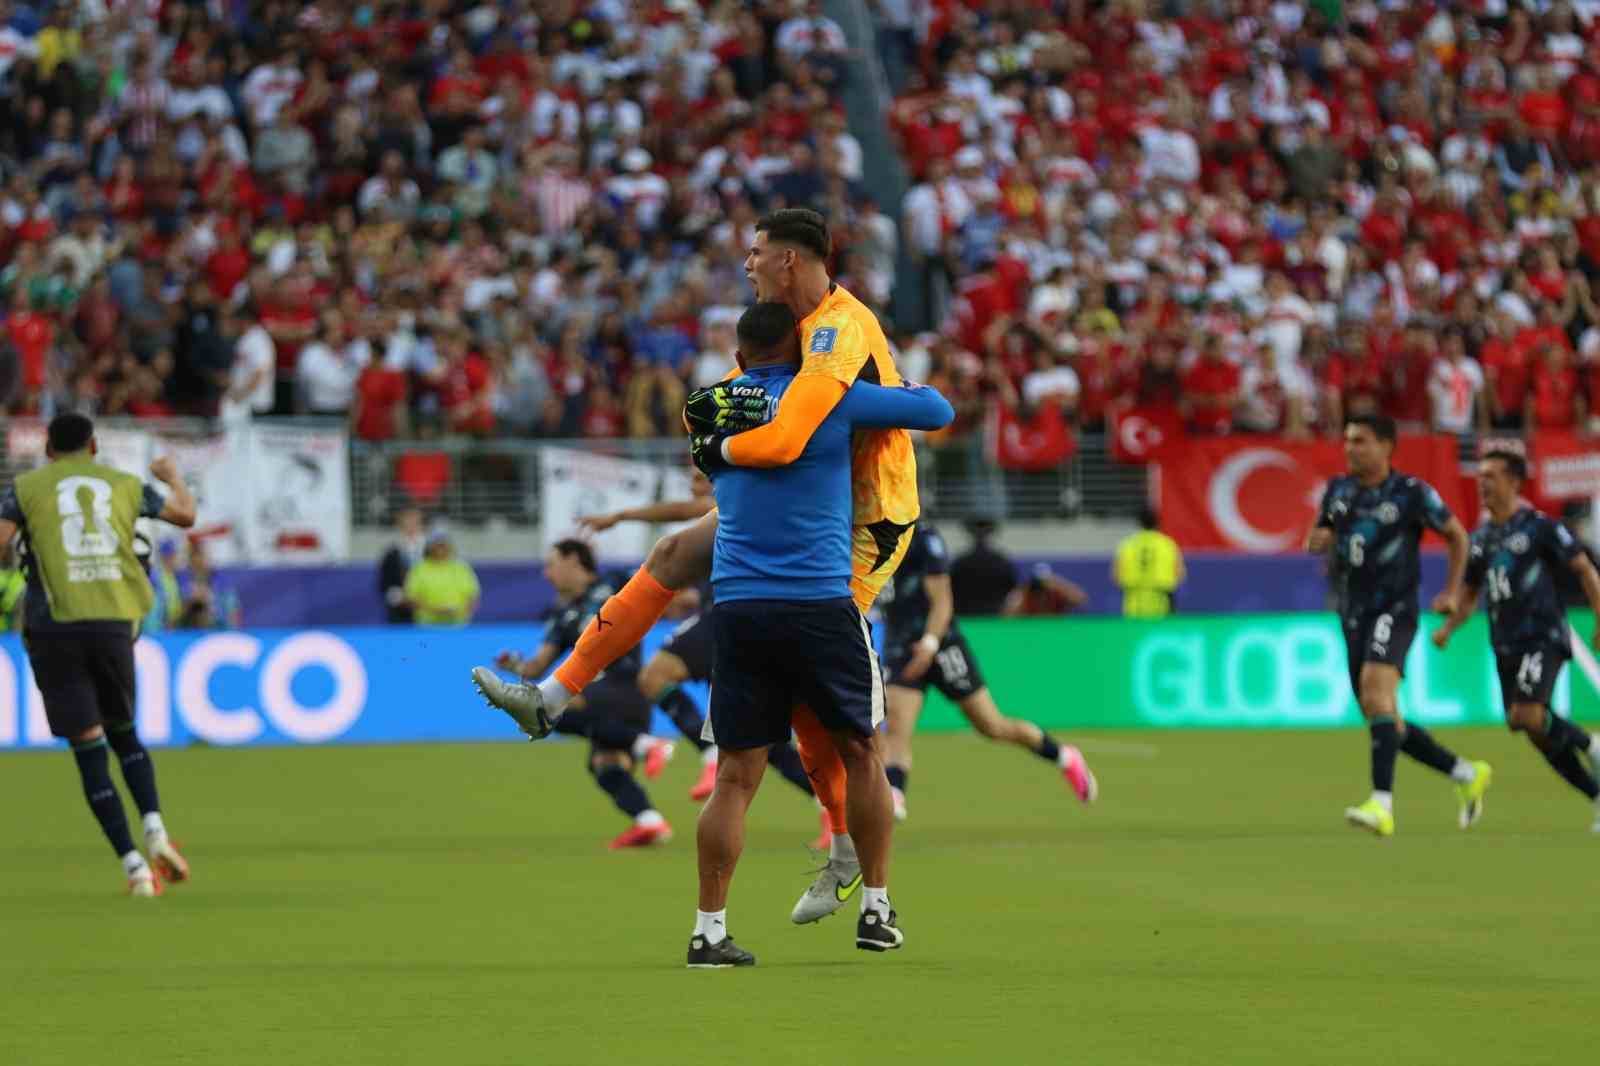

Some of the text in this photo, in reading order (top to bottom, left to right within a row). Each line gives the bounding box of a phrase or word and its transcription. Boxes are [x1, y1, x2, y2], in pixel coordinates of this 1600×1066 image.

[732, 386, 764, 397] Volt
[1349, 533, 1366, 567] 6
[1487, 566, 1512, 602] 14
[1373, 612, 1394, 644] 6
[1131, 624, 1465, 729] GLOBL
[1516, 651, 1543, 684] 14
